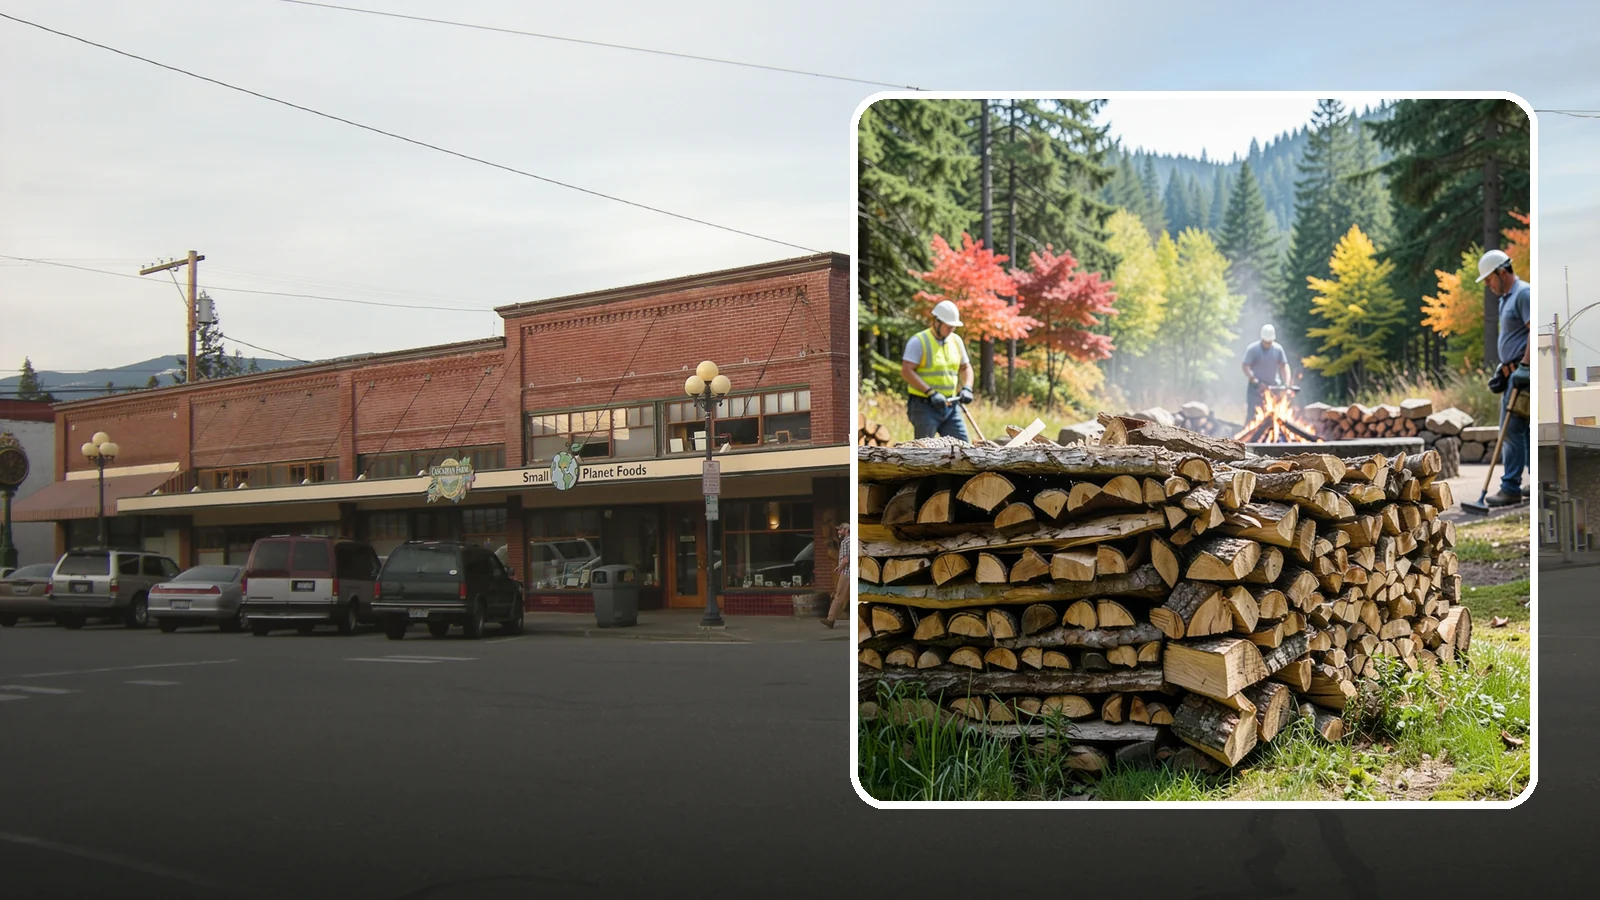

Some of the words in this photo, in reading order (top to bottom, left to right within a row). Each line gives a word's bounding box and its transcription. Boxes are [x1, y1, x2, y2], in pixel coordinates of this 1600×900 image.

[431, 466, 455, 476] CASCADIAN
[455, 465, 469, 475] FARM
[523, 471, 549, 483] Small
[583, 468, 614, 479] Planet
[617, 464, 647, 477] Foods
